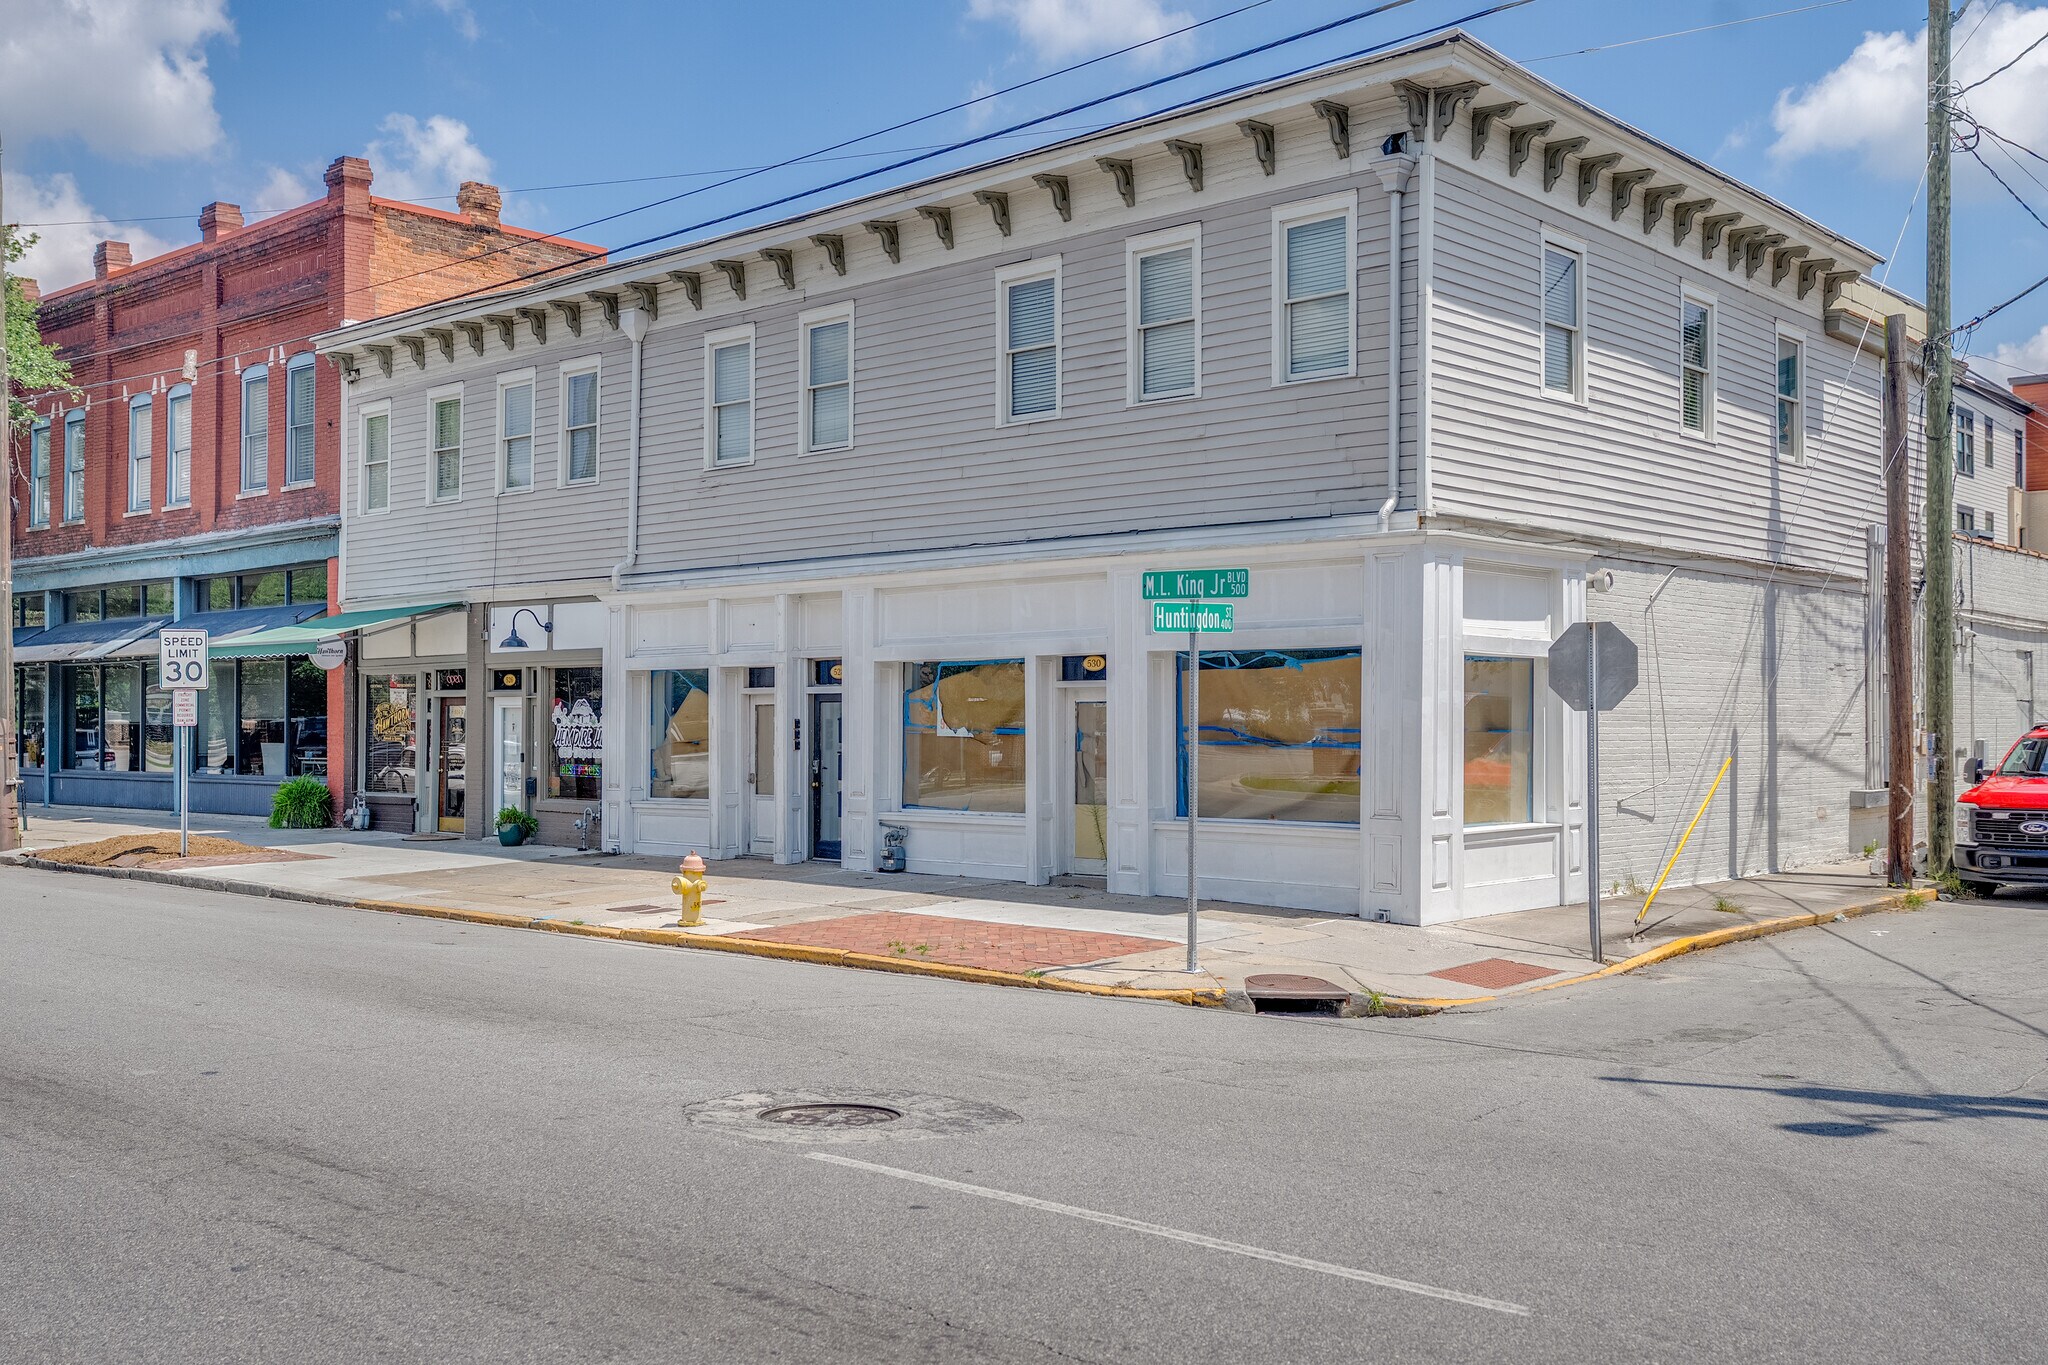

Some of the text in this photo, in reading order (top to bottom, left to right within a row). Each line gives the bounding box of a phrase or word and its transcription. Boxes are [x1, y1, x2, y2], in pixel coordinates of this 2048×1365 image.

[1227, 571, 1246, 583] BLVD
[1146, 573, 1225, 598] M.L. King Jr
[1231, 583, 1246, 595] 500
[1156, 606, 1220, 632] Huntingdon
[164, 637, 203, 646] SPEED
[168, 649, 198, 658] LIMIT
[1087, 659, 1101, 668] 530
[165, 660, 202, 682] 30
